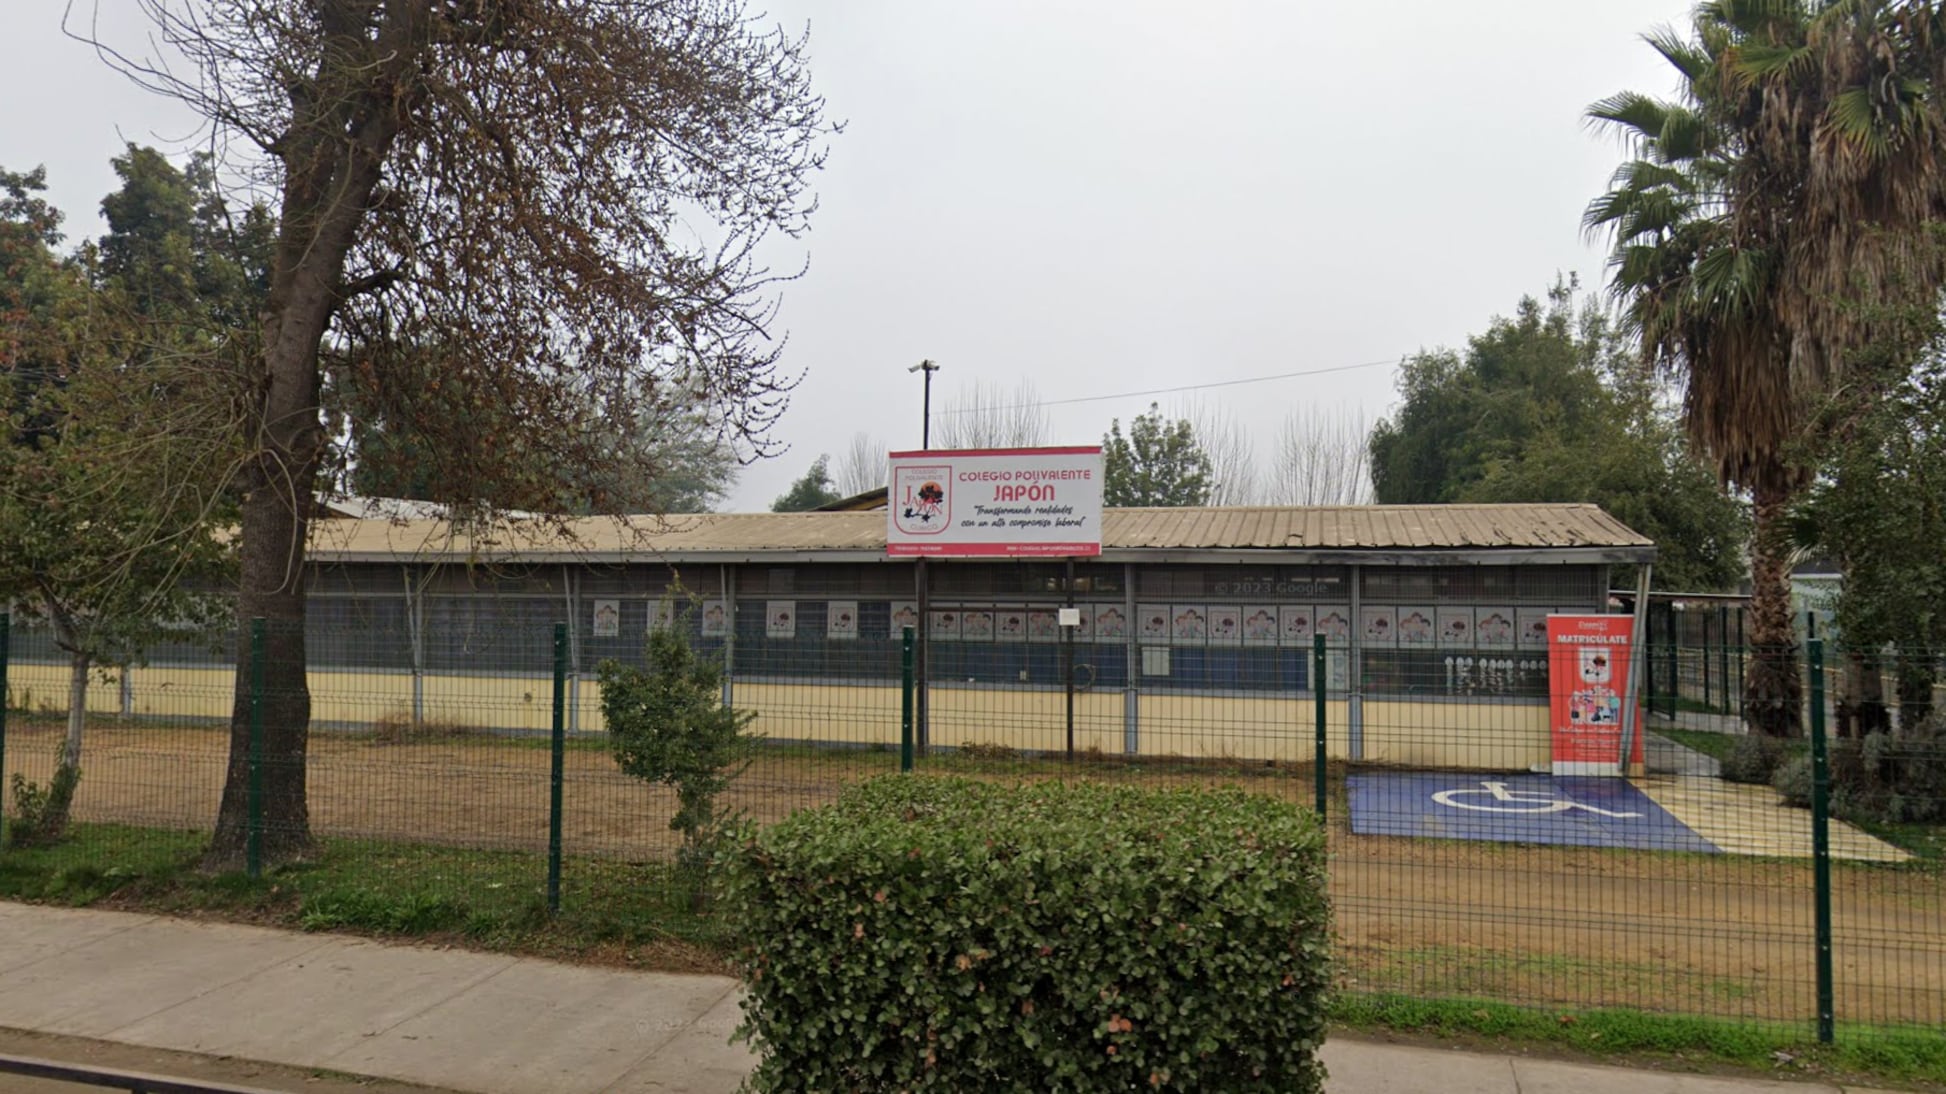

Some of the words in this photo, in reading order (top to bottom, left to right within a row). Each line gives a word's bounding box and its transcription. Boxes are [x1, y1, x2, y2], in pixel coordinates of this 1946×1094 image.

[959, 471, 1012, 482] COLEGIO
[1015, 470, 1091, 481] POLIVALENTE
[993, 480, 1055, 502] JAPÓN
[960, 520, 975, 528] con
[991, 518, 1005, 528] alto
[1009, 519, 1052, 529] compromiso
